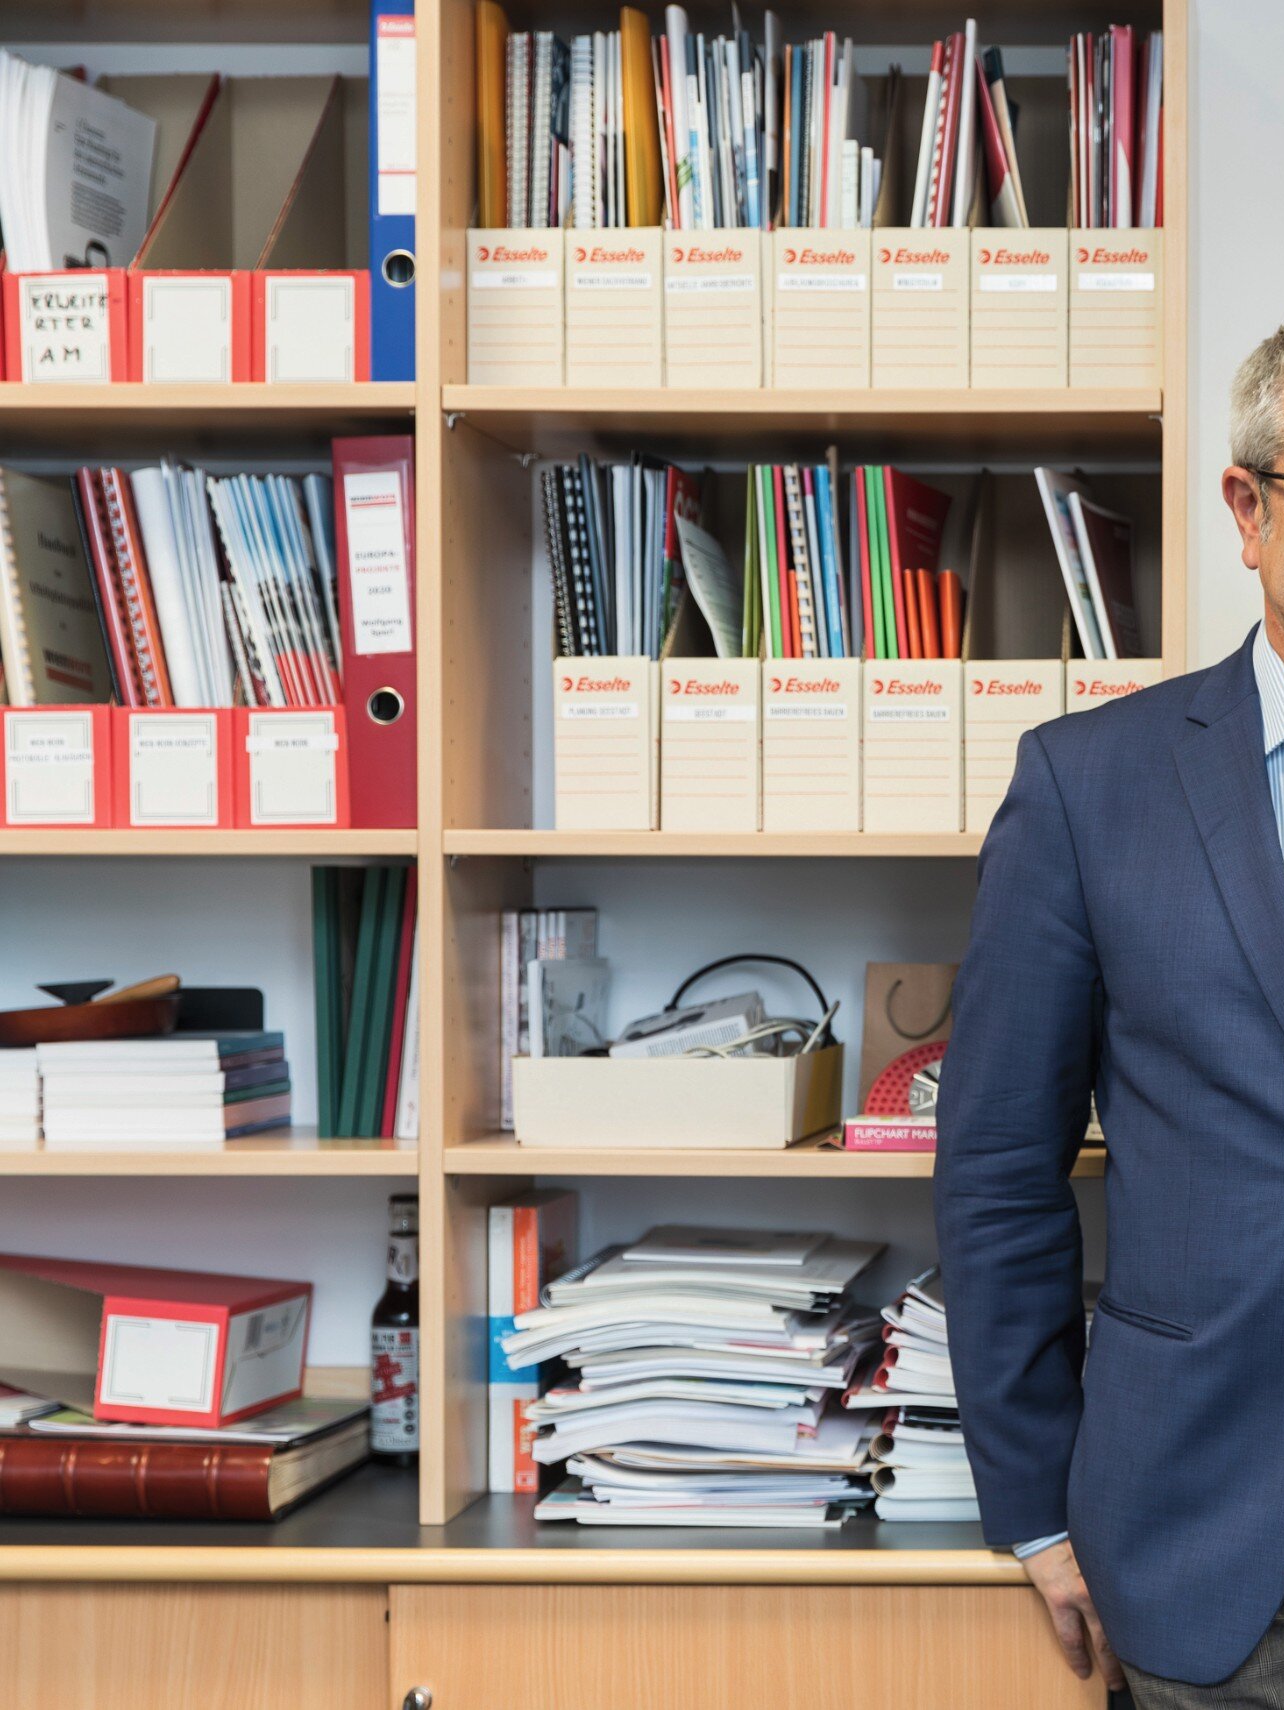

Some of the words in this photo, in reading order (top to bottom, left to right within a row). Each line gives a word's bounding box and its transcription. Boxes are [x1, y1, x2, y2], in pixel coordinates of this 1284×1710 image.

[491, 246, 548, 263] Esselte
[589, 247, 646, 263] Esselte
[687, 246, 743, 263] Esselte
[799, 247, 856, 265] Esselte
[893, 247, 951, 265] Esselte
[994, 248, 1050, 265] Esselte
[1091, 247, 1148, 265] Esselte
[575, 676, 631, 692] Esselte
[684, 679, 740, 695] Esselte
[785, 677, 840, 693] Esselte
[887, 679, 942, 695] Esselte
[986, 679, 1043, 695] Esselte
[854, 1127, 909, 1139] FLIPCHART
[912, 1129, 937, 1140] MAR
